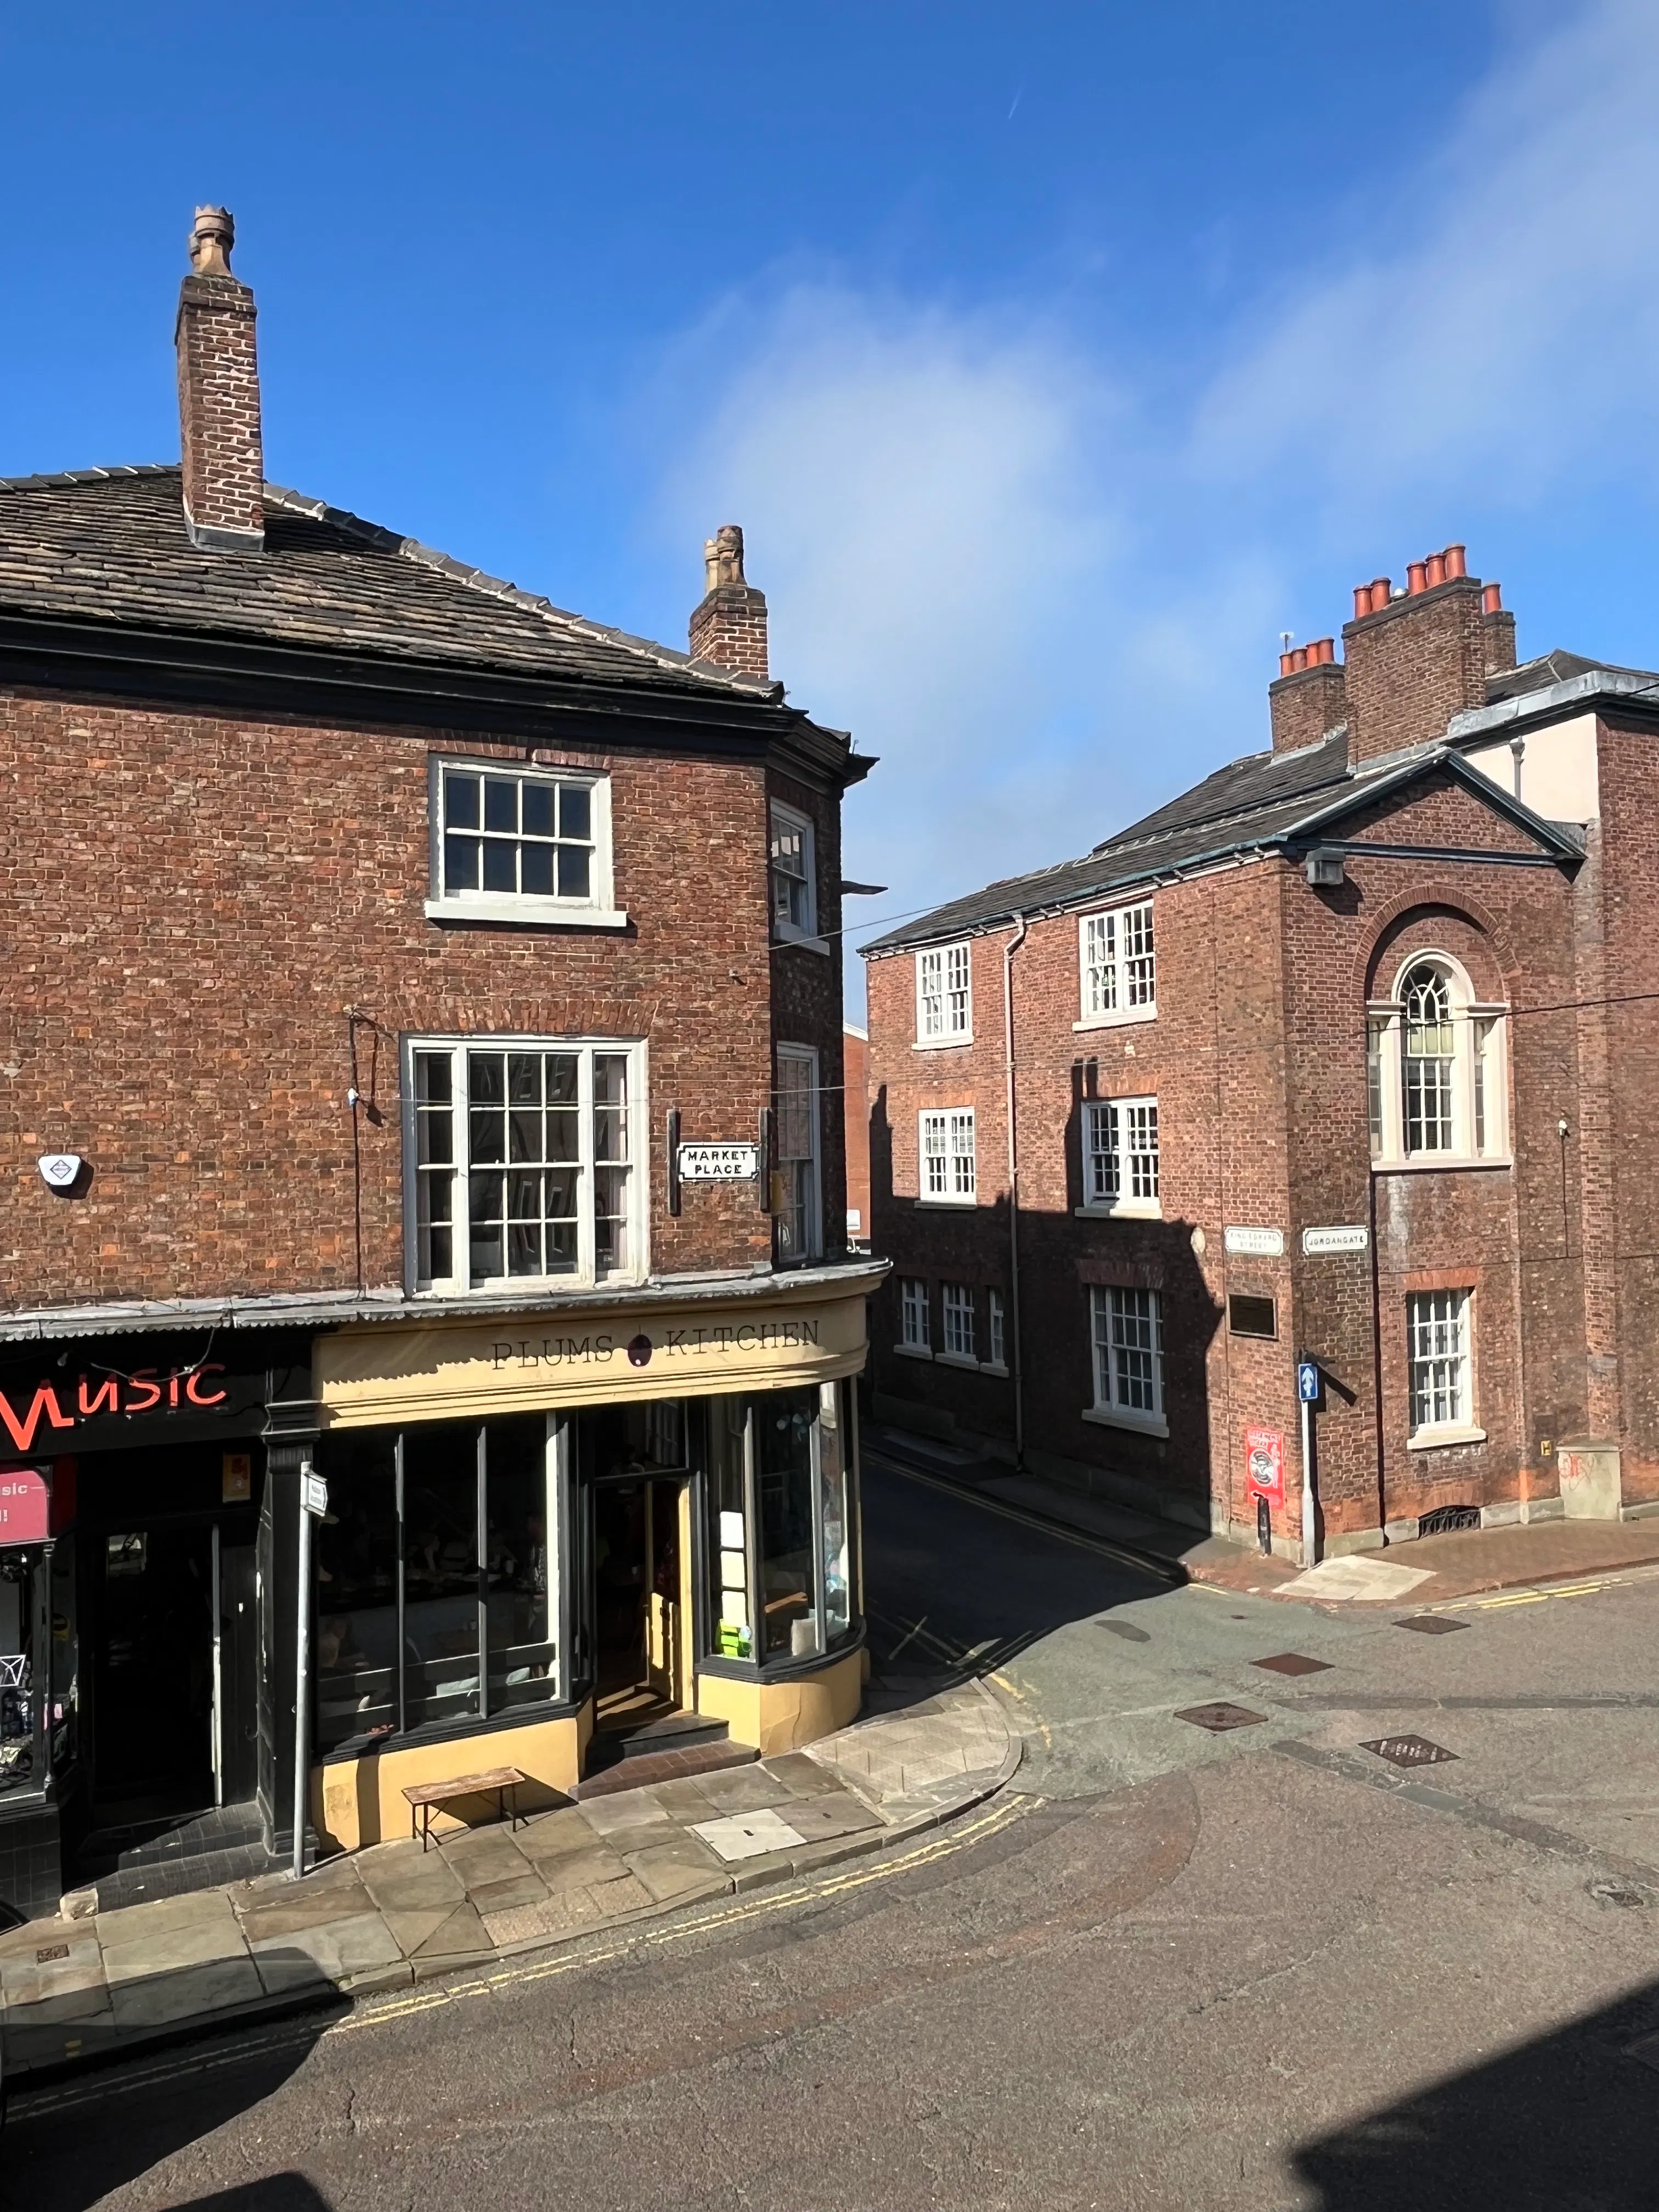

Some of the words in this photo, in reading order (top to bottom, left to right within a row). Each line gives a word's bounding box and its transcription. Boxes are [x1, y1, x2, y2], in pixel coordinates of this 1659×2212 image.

[688, 1150, 748, 1161] MARKET
[695, 1165, 742, 1175] PLACE
[1309, 1235, 1364, 1245] JORDANGATE
[492, 1335, 613, 1370] PLUMS
[665, 1320, 819, 1356] KITCHEN
[0, 1482, 27, 1496] sic
